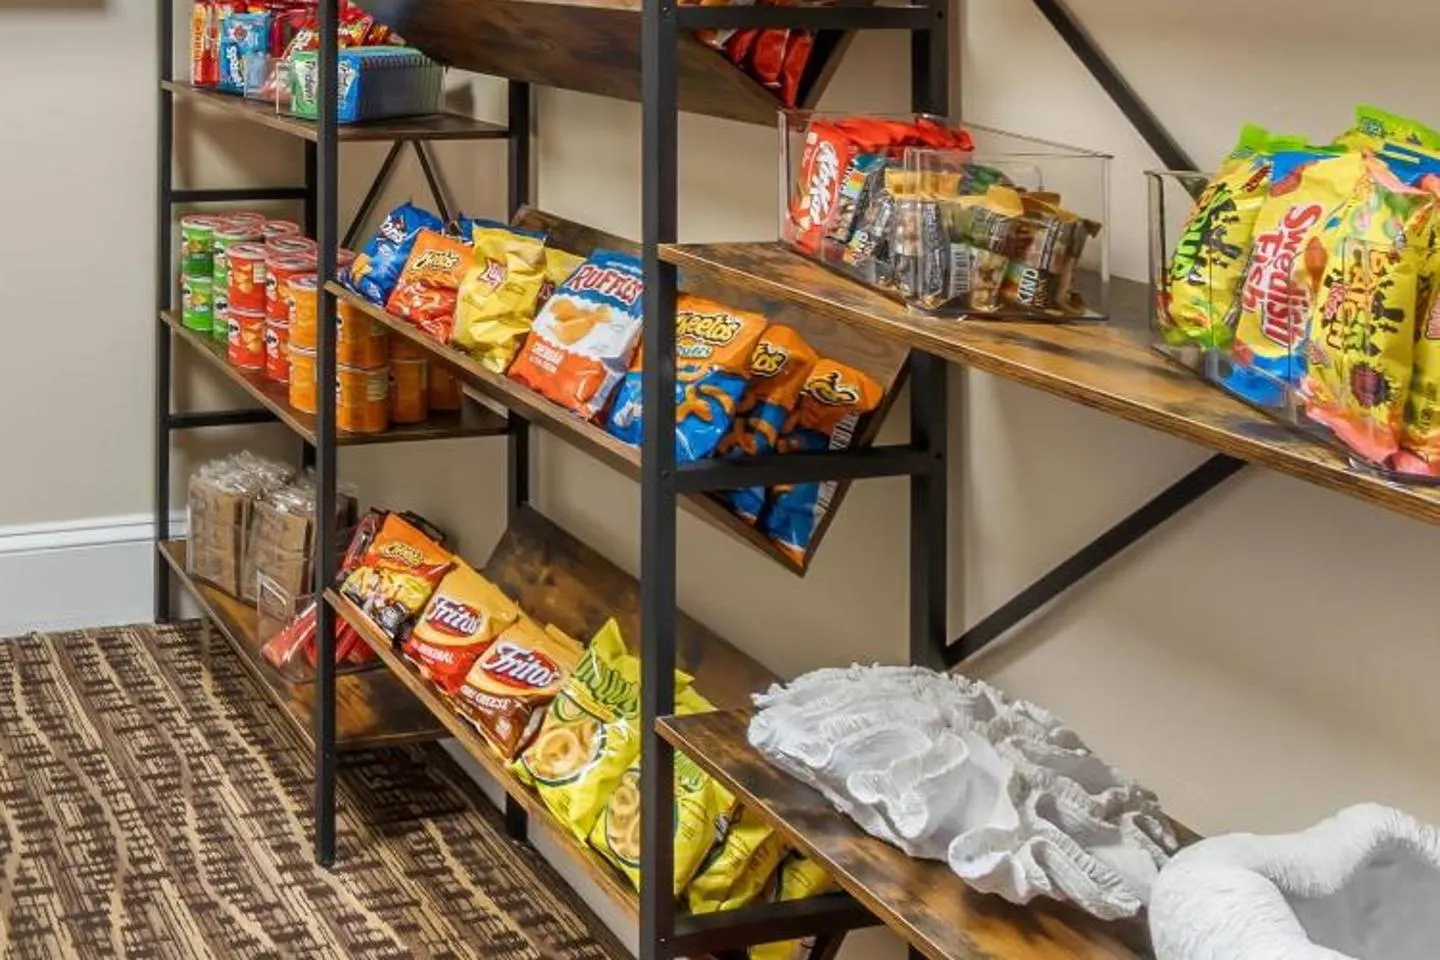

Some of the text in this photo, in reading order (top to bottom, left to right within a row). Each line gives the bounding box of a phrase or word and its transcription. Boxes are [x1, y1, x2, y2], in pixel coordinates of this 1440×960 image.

[1016, 268, 1039, 305] KIND
[427, 595, 482, 637] Fritos
[480, 640, 561, 690] Fritos
